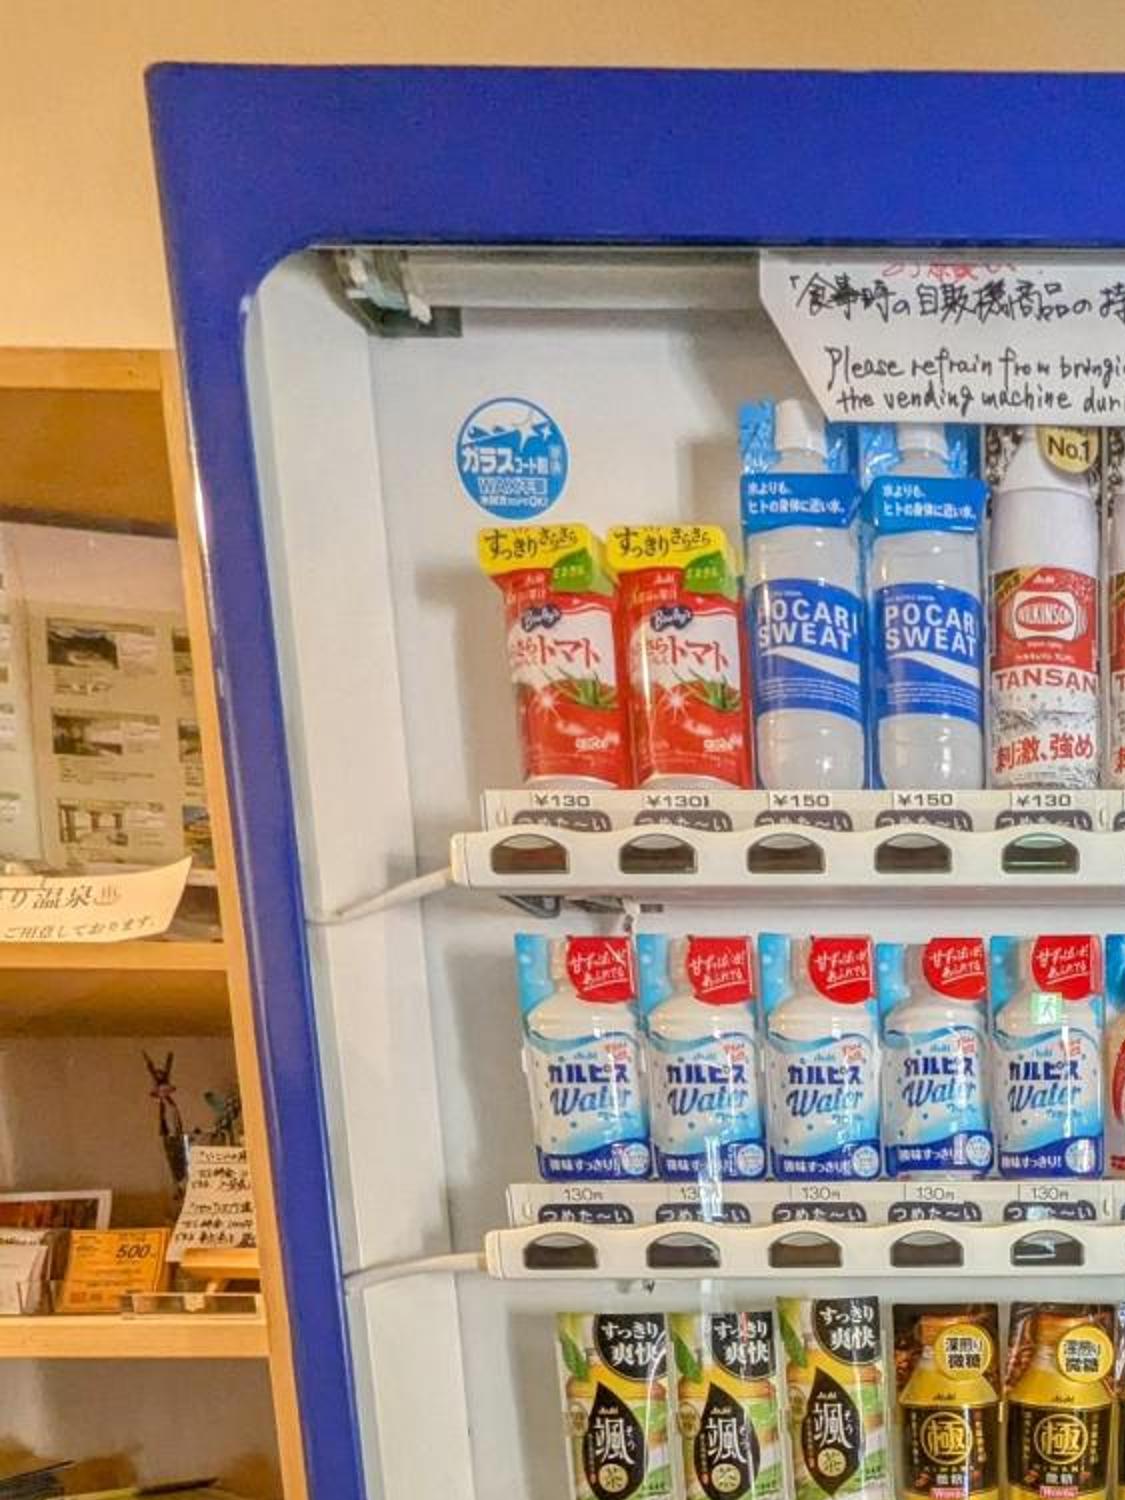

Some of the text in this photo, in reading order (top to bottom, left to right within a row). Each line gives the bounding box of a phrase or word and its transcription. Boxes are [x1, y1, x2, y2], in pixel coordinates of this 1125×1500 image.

[824, 346, 904, 391] Please
[911, 349, 993, 385] refrain
[999, 347, 1050, 390] from
[837, 388, 875, 413] the
[883, 380, 975, 417] vending
[981, 384, 1073, 411] machine
[1046, 436, 1095, 461] No.1
[484, 528, 538, 560] すっきり
[614, 528, 670, 559] すっきり
[758, 624, 852, 653] SWEAT
[884, 628, 977, 657] SWEAT
[995, 669, 1098, 696] TANSAN
[995, 732, 1094, 774] 刺激、強め
[547, 1064, 630, 1083] カルピス
[667, 1064, 747, 1084] カルピス
[787, 1065, 863, 1085] カルピス
[1009, 1060, 1080, 1081] カルピス
[786, 1086, 863, 1118] Water
[1008, 1082, 1082, 1113] Water
[819, 1304, 875, 1325] すっきり
[601, 1322, 659, 1340] すっきり
[830, 1326, 876, 1351] 爽快
[611, 1343, 661, 1367] 爽快
[724, 1343, 770, 1366] 爽快
[813, 1402, 854, 1449] 颯
[926, 1419, 966, 1456] 極
[1040, 1421, 1081, 1455] 極
[594, 1417, 636, 1465] 颯
[705, 1417, 748, 1464] 颯
